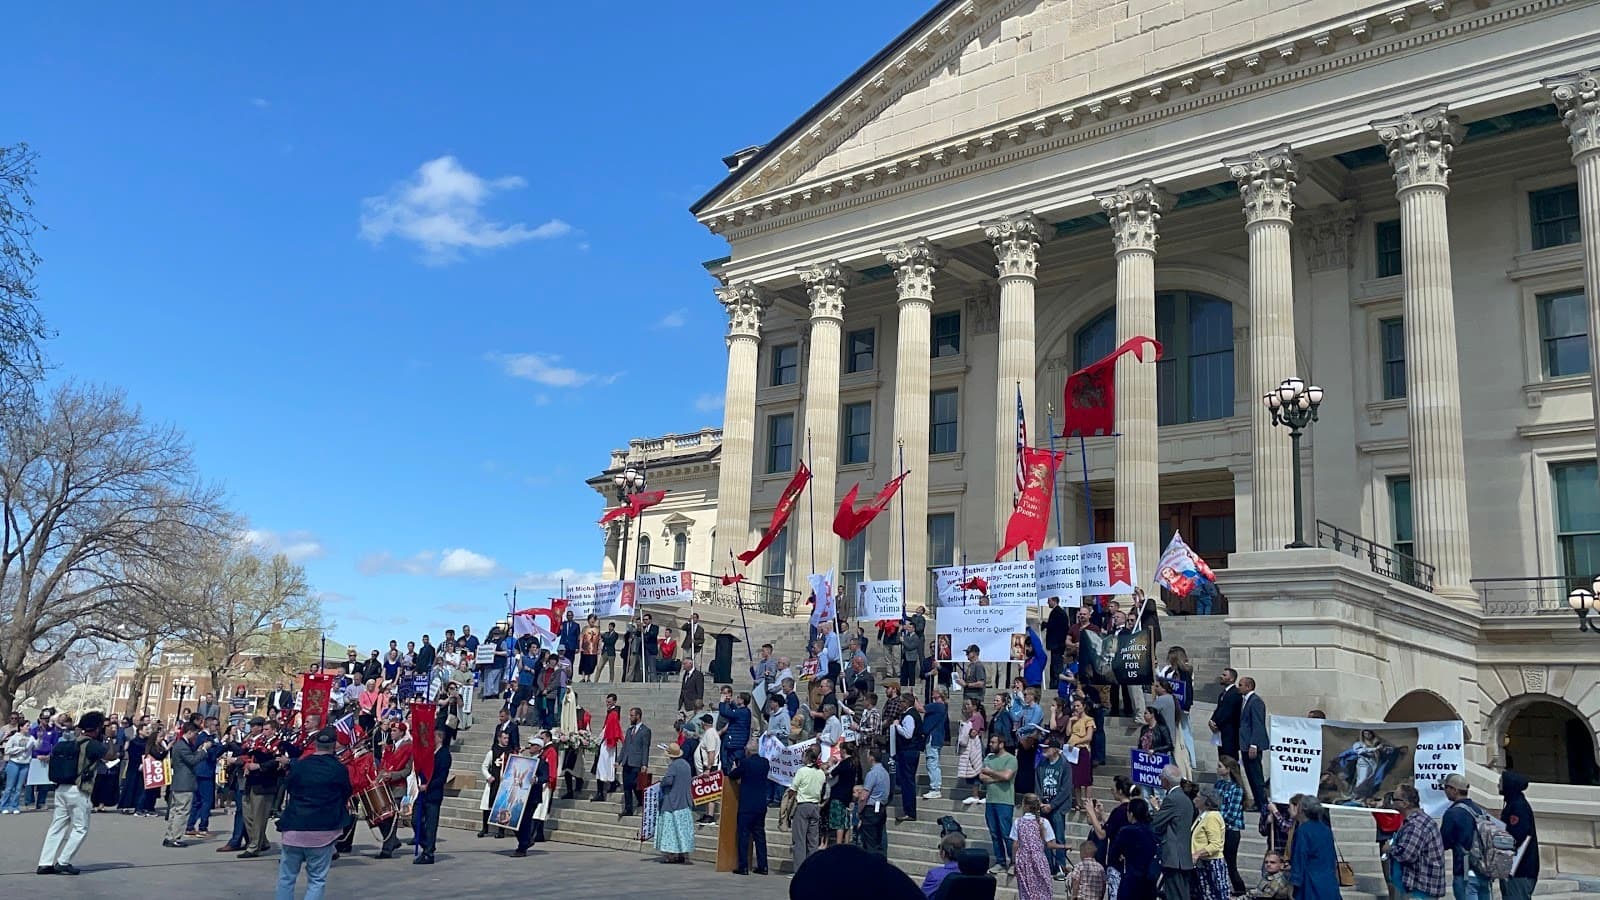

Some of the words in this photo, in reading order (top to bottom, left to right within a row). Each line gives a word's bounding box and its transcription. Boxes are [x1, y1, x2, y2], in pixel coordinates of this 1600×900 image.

[1055, 553, 1079, 564] accept
[1097, 564, 1107, 573] for
[659, 573, 678, 584] has
[993, 582, 1020, 590] serpent
[649, 585, 679, 600] rights!
[875, 594, 898, 603] Needs
[874, 604, 900, 614] Fatima
[963, 608, 981, 616] Christ
[989, 608, 1004, 616] King
[993, 626, 1015, 634] Queen
[1120, 644, 1147, 654] PATRICK
[1282, 737, 1307, 746] IPSA
[1270, 745, 1321, 756] CONTERET
[1138, 752, 1163, 765] STOP
[1279, 755, 1312, 764] CAPUT
[152, 760, 164, 783] God
[1133, 762, 1163, 774] Blasphem
[1282, 764, 1309, 773] TUUM
[1417, 763, 1458, 771] VICTORY
[692, 777, 703, 787] We
[704, 773, 721, 783] want
[1139, 773, 1162, 786] NOW
[694, 780, 723, 796] God.
